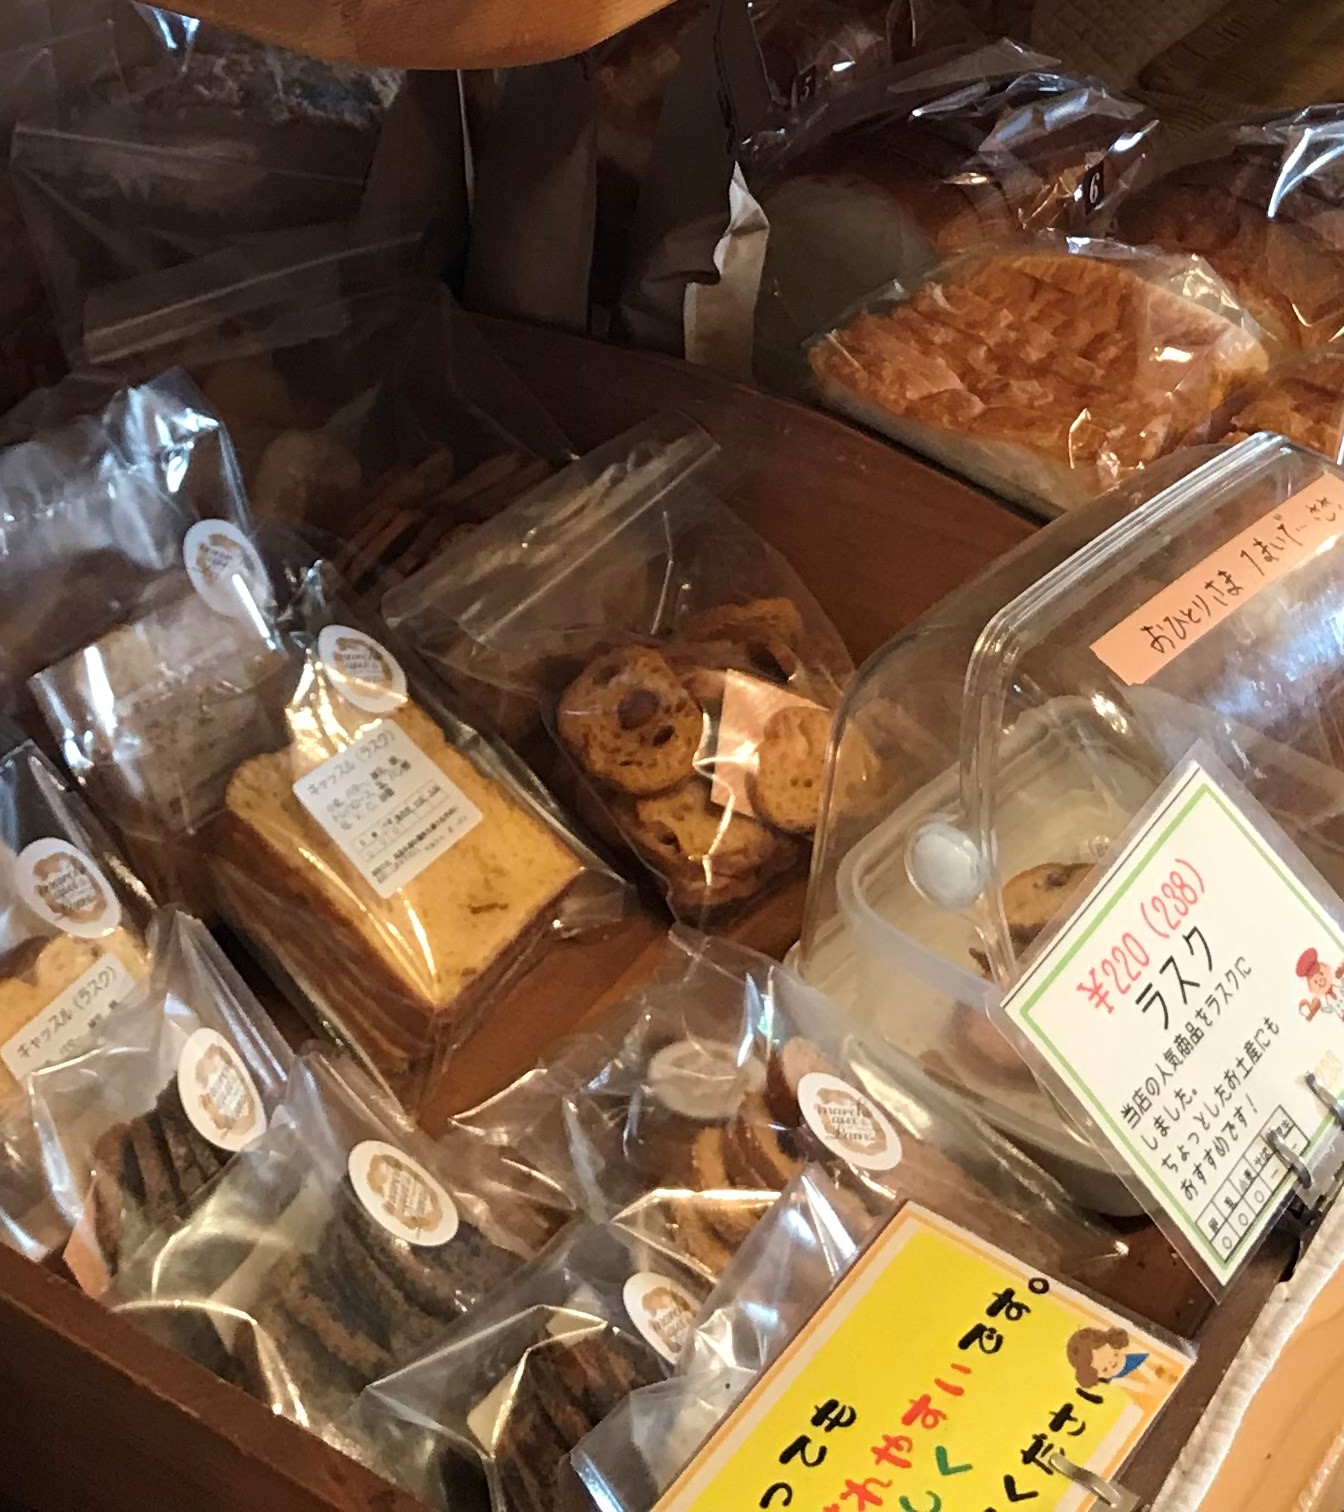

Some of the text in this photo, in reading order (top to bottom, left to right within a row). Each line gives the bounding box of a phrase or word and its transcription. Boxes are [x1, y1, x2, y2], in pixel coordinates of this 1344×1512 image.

[1089, 172, 1101, 204] 6
[1140, 569, 1244, 654] おひとりさま
[1077, 858, 1207, 1016] ¥220 (238)
[1134, 926, 1215, 1031] ラスク
[1120, 956, 1254, 1130] 当店の人気商品をラスクに
[1161, 1015, 1281, 1174] ちょっとしたお土産にも
[1138, 1086, 1201, 1152] しました。
[1179, 1092, 1262, 1202] おすすめです!
[822, 1276, 1050, 1512] れやすいです。
[982, 1385, 1105, 1512] ください
